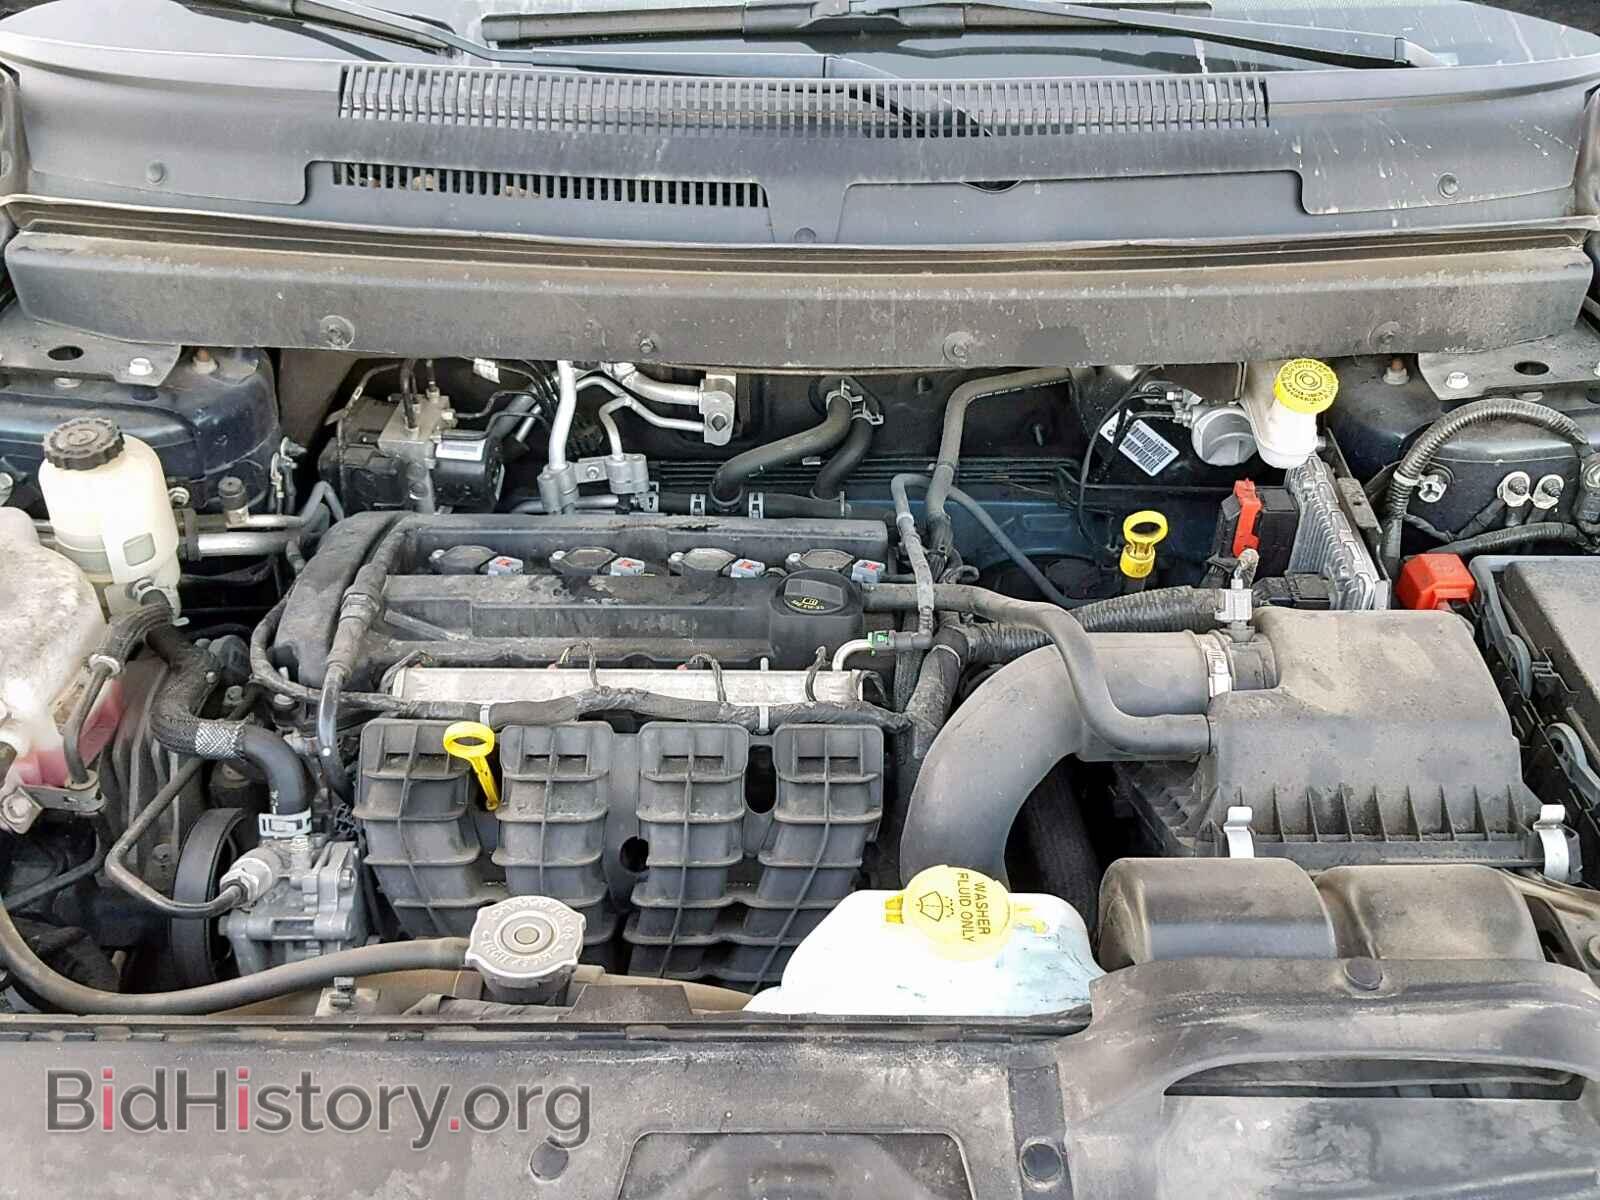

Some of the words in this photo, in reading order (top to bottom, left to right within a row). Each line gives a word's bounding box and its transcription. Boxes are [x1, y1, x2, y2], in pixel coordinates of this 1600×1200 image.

[956, 872, 972, 907] FLUID
[973, 881, 991, 935] WASHER
[960, 911, 975, 942] ONLY
